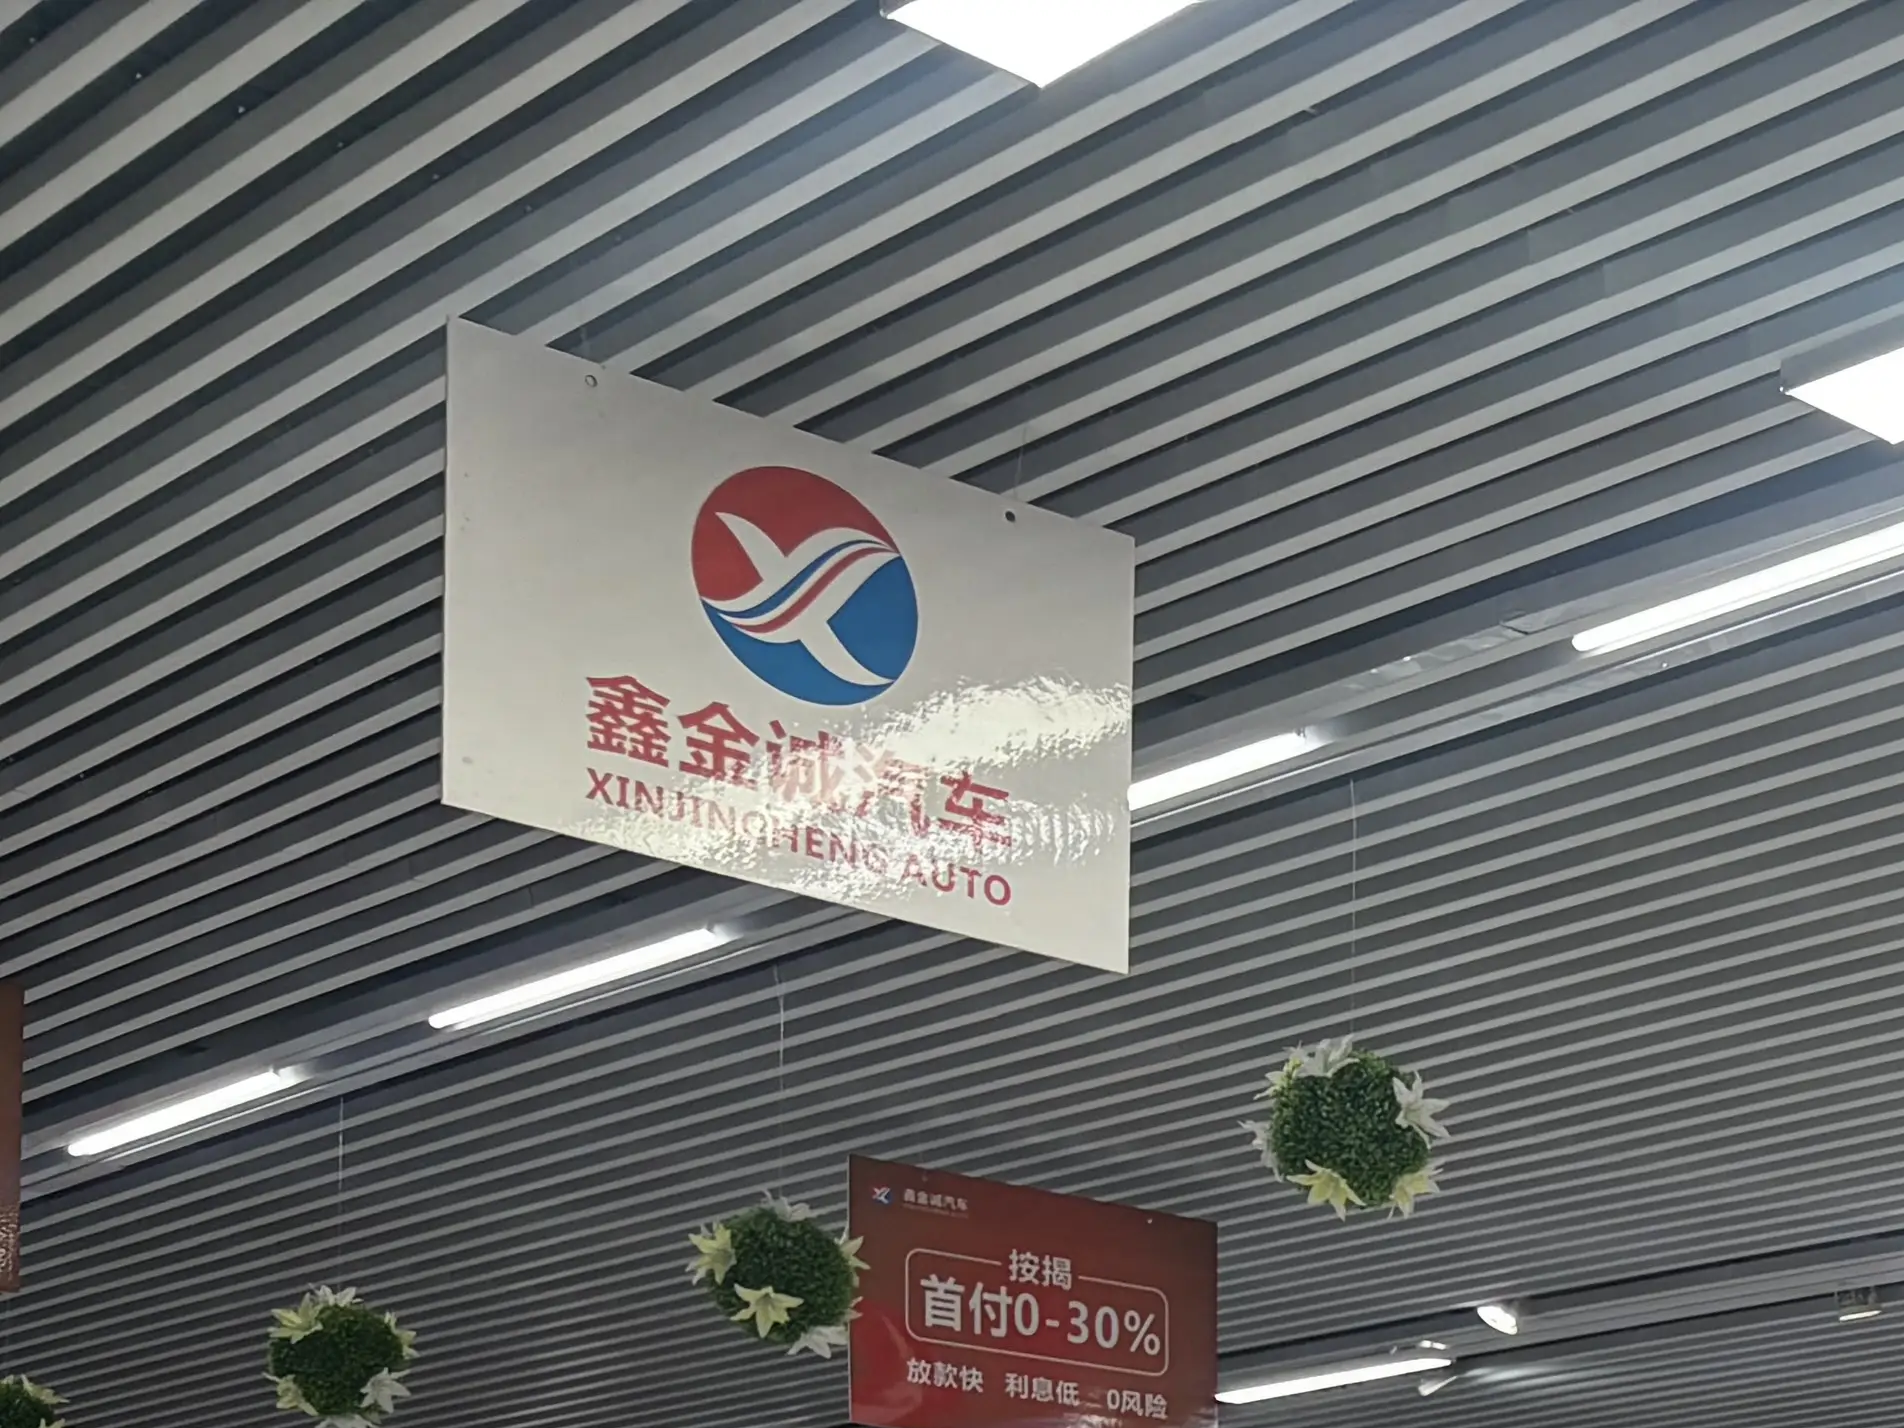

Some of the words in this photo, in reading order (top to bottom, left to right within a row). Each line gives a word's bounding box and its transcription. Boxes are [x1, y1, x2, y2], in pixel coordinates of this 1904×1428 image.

[900, 853, 1012, 906] AUTO
[1009, 1249, 1072, 1290] 按揭
[920, 1274, 1161, 1356] 首付0-30%
[907, 1358, 984, 1393] 放款快
[1005, 1372, 1080, 1407] 利息低
[1107, 1388, 1168, 1420] 0风险
